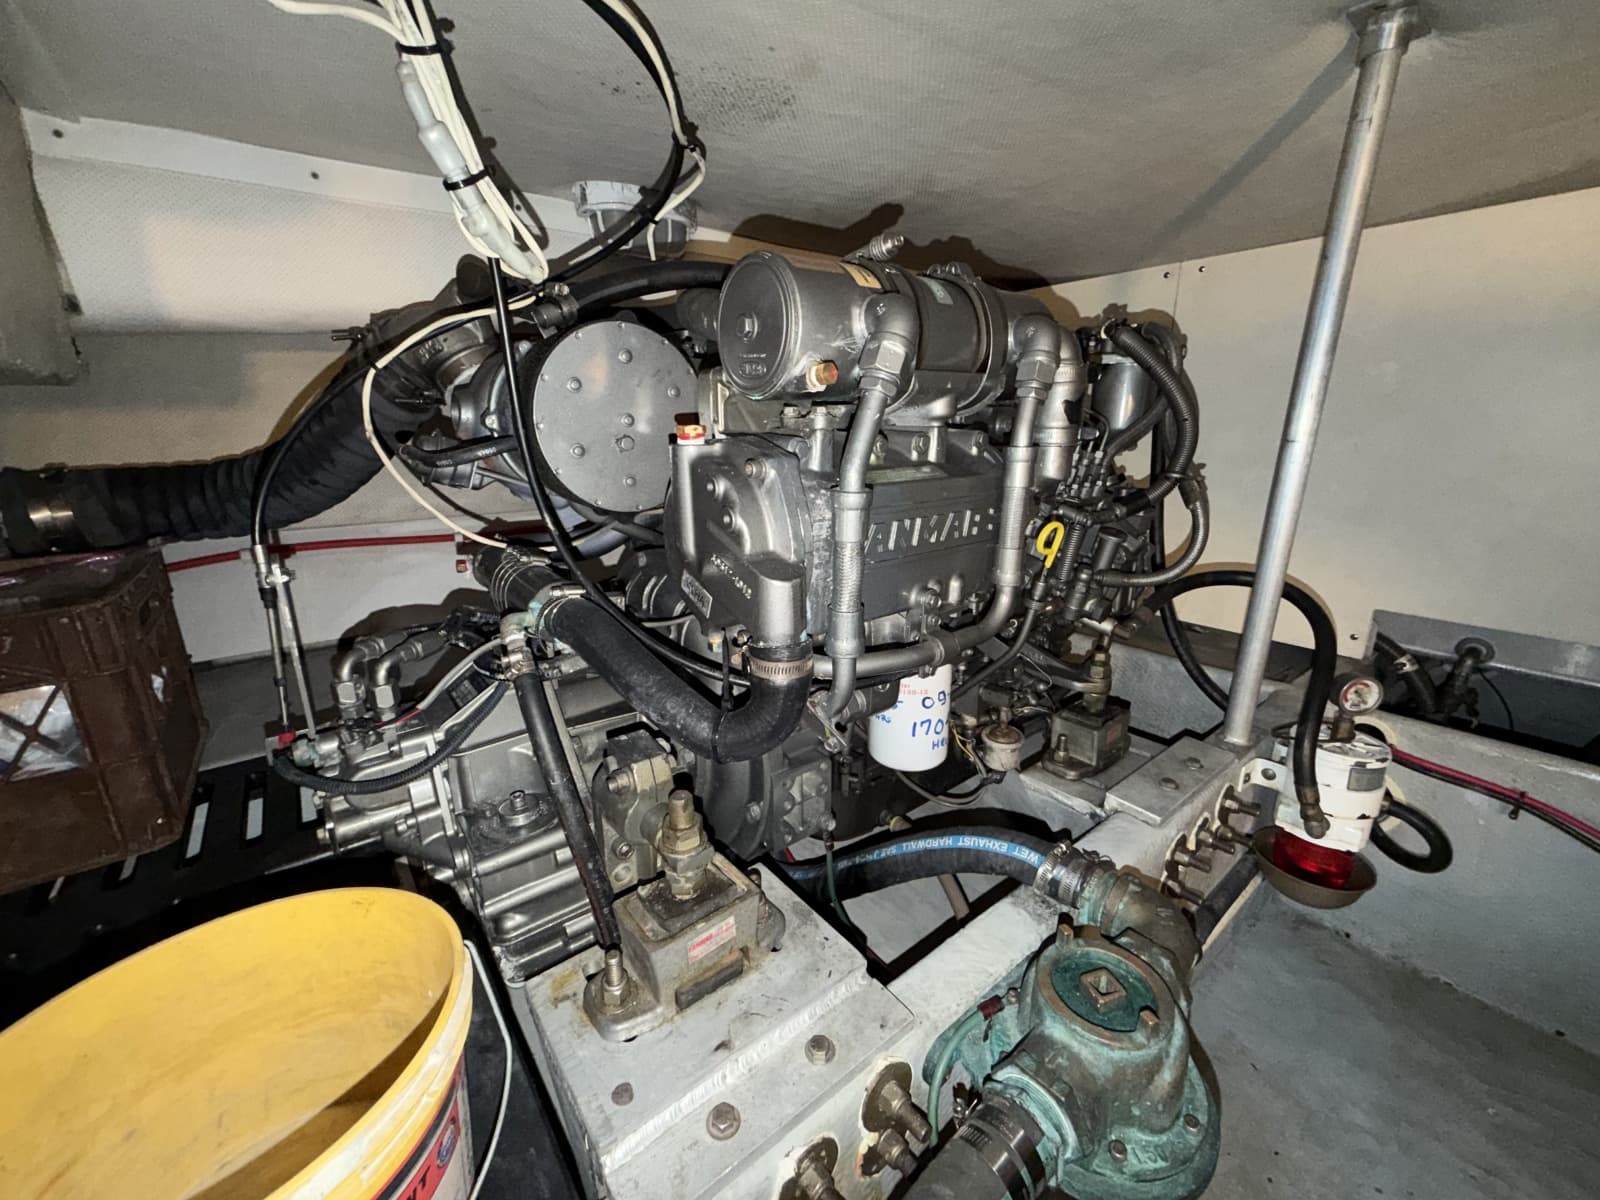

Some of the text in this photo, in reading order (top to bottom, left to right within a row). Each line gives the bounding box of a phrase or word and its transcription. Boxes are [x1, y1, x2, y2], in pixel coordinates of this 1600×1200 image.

[863, 509, 984, 555] ANMAR
[902, 836, 953, 851] HARDWALL
[957, 836, 1008, 853] EXHAUST
[1011, 846, 1040, 864] WET
